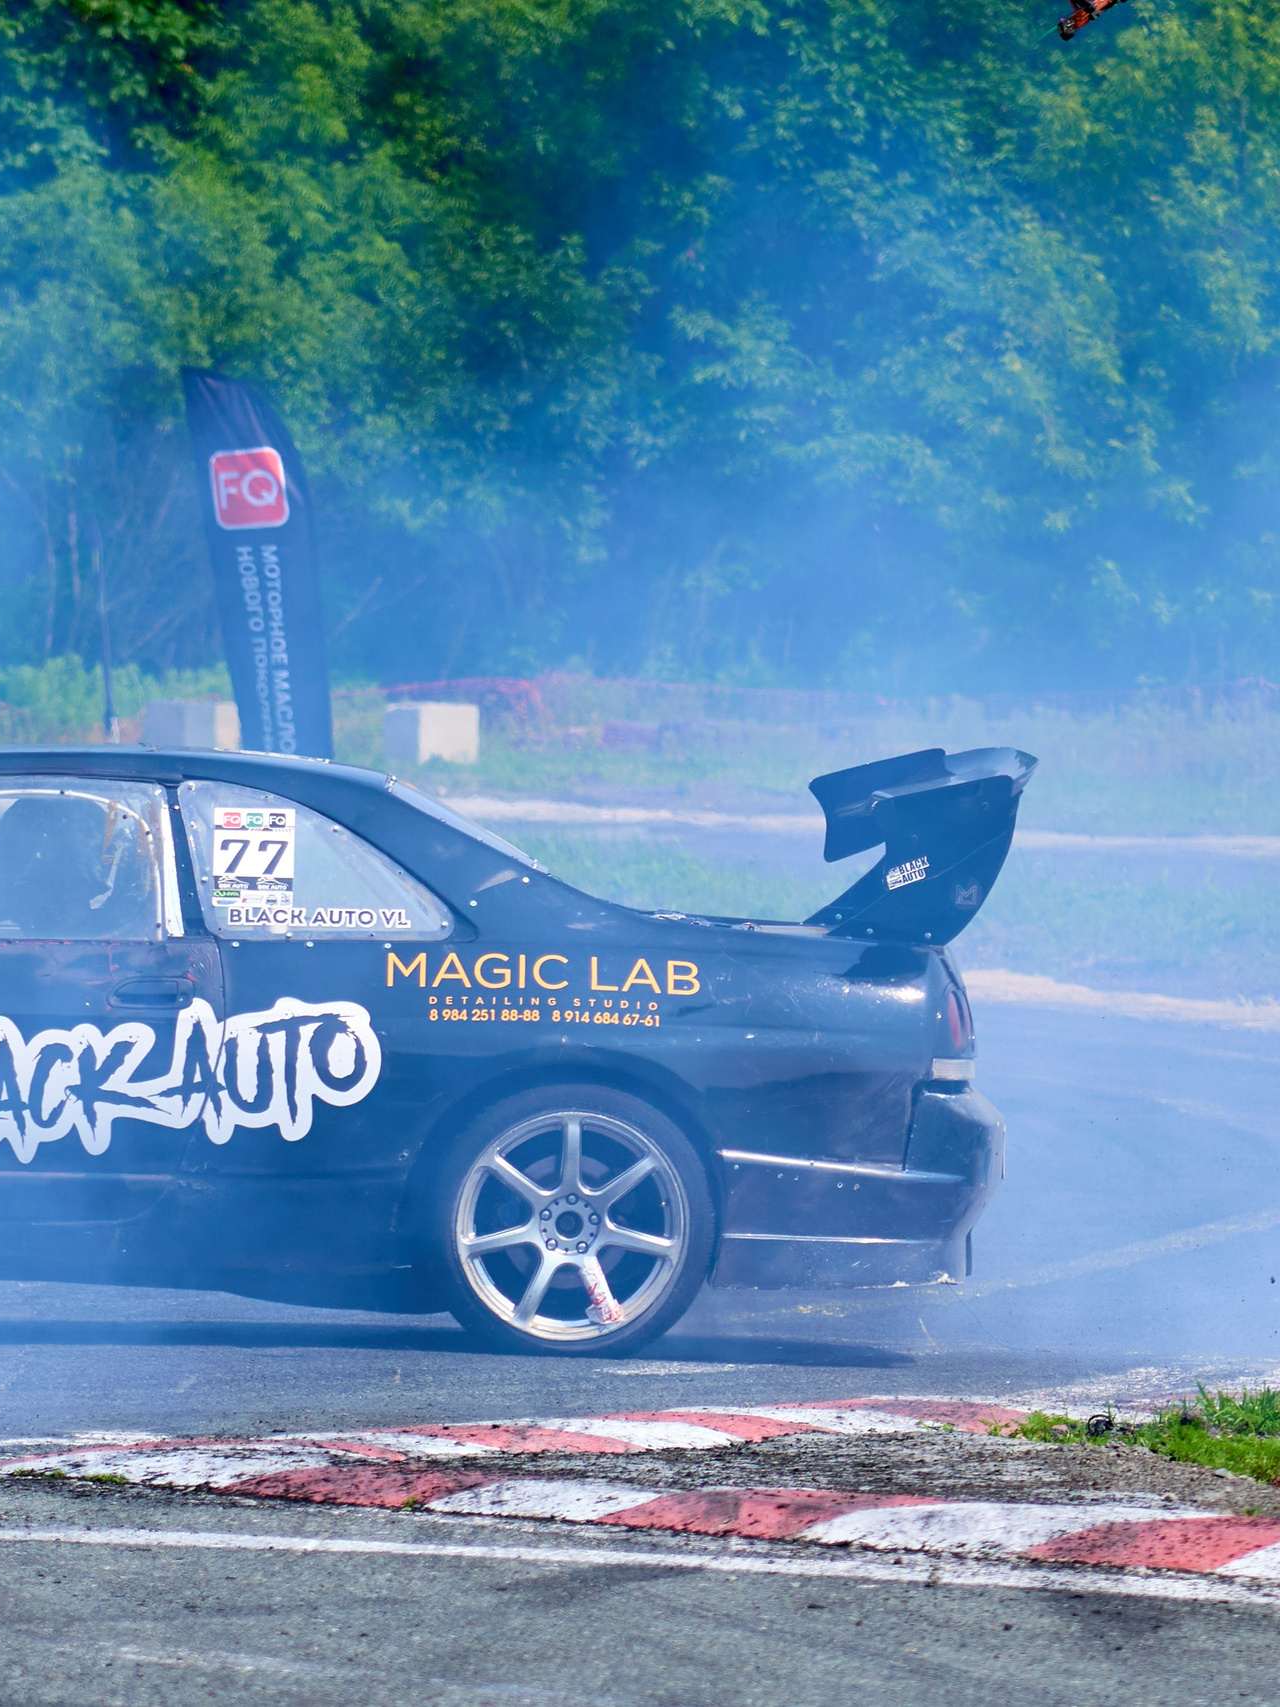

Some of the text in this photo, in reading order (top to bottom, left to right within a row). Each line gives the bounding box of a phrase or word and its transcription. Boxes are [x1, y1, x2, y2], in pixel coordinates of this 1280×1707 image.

[219, 469, 278, 508] FQ
[236, 546, 265, 632] НОВОГО
[261, 545, 297, 754] МОТОРНОЕ МАСЛО
[224, 815, 286, 826] FQ FQ FQ
[220, 839, 288, 875] 77
[899, 856, 928, 875] BLACK
[902, 868, 925, 884] AUTO
[230, 908, 408, 926] BLACK AUTO VL
[387, 952, 701, 996] MAGIC LAB
[429, 996, 658, 1011] DETAILING STUDIO
[429, 1009, 660, 1027] 8 984 251 88-88 8 914 684 67-61
[158, 1010, 370, 1130] AUTO
